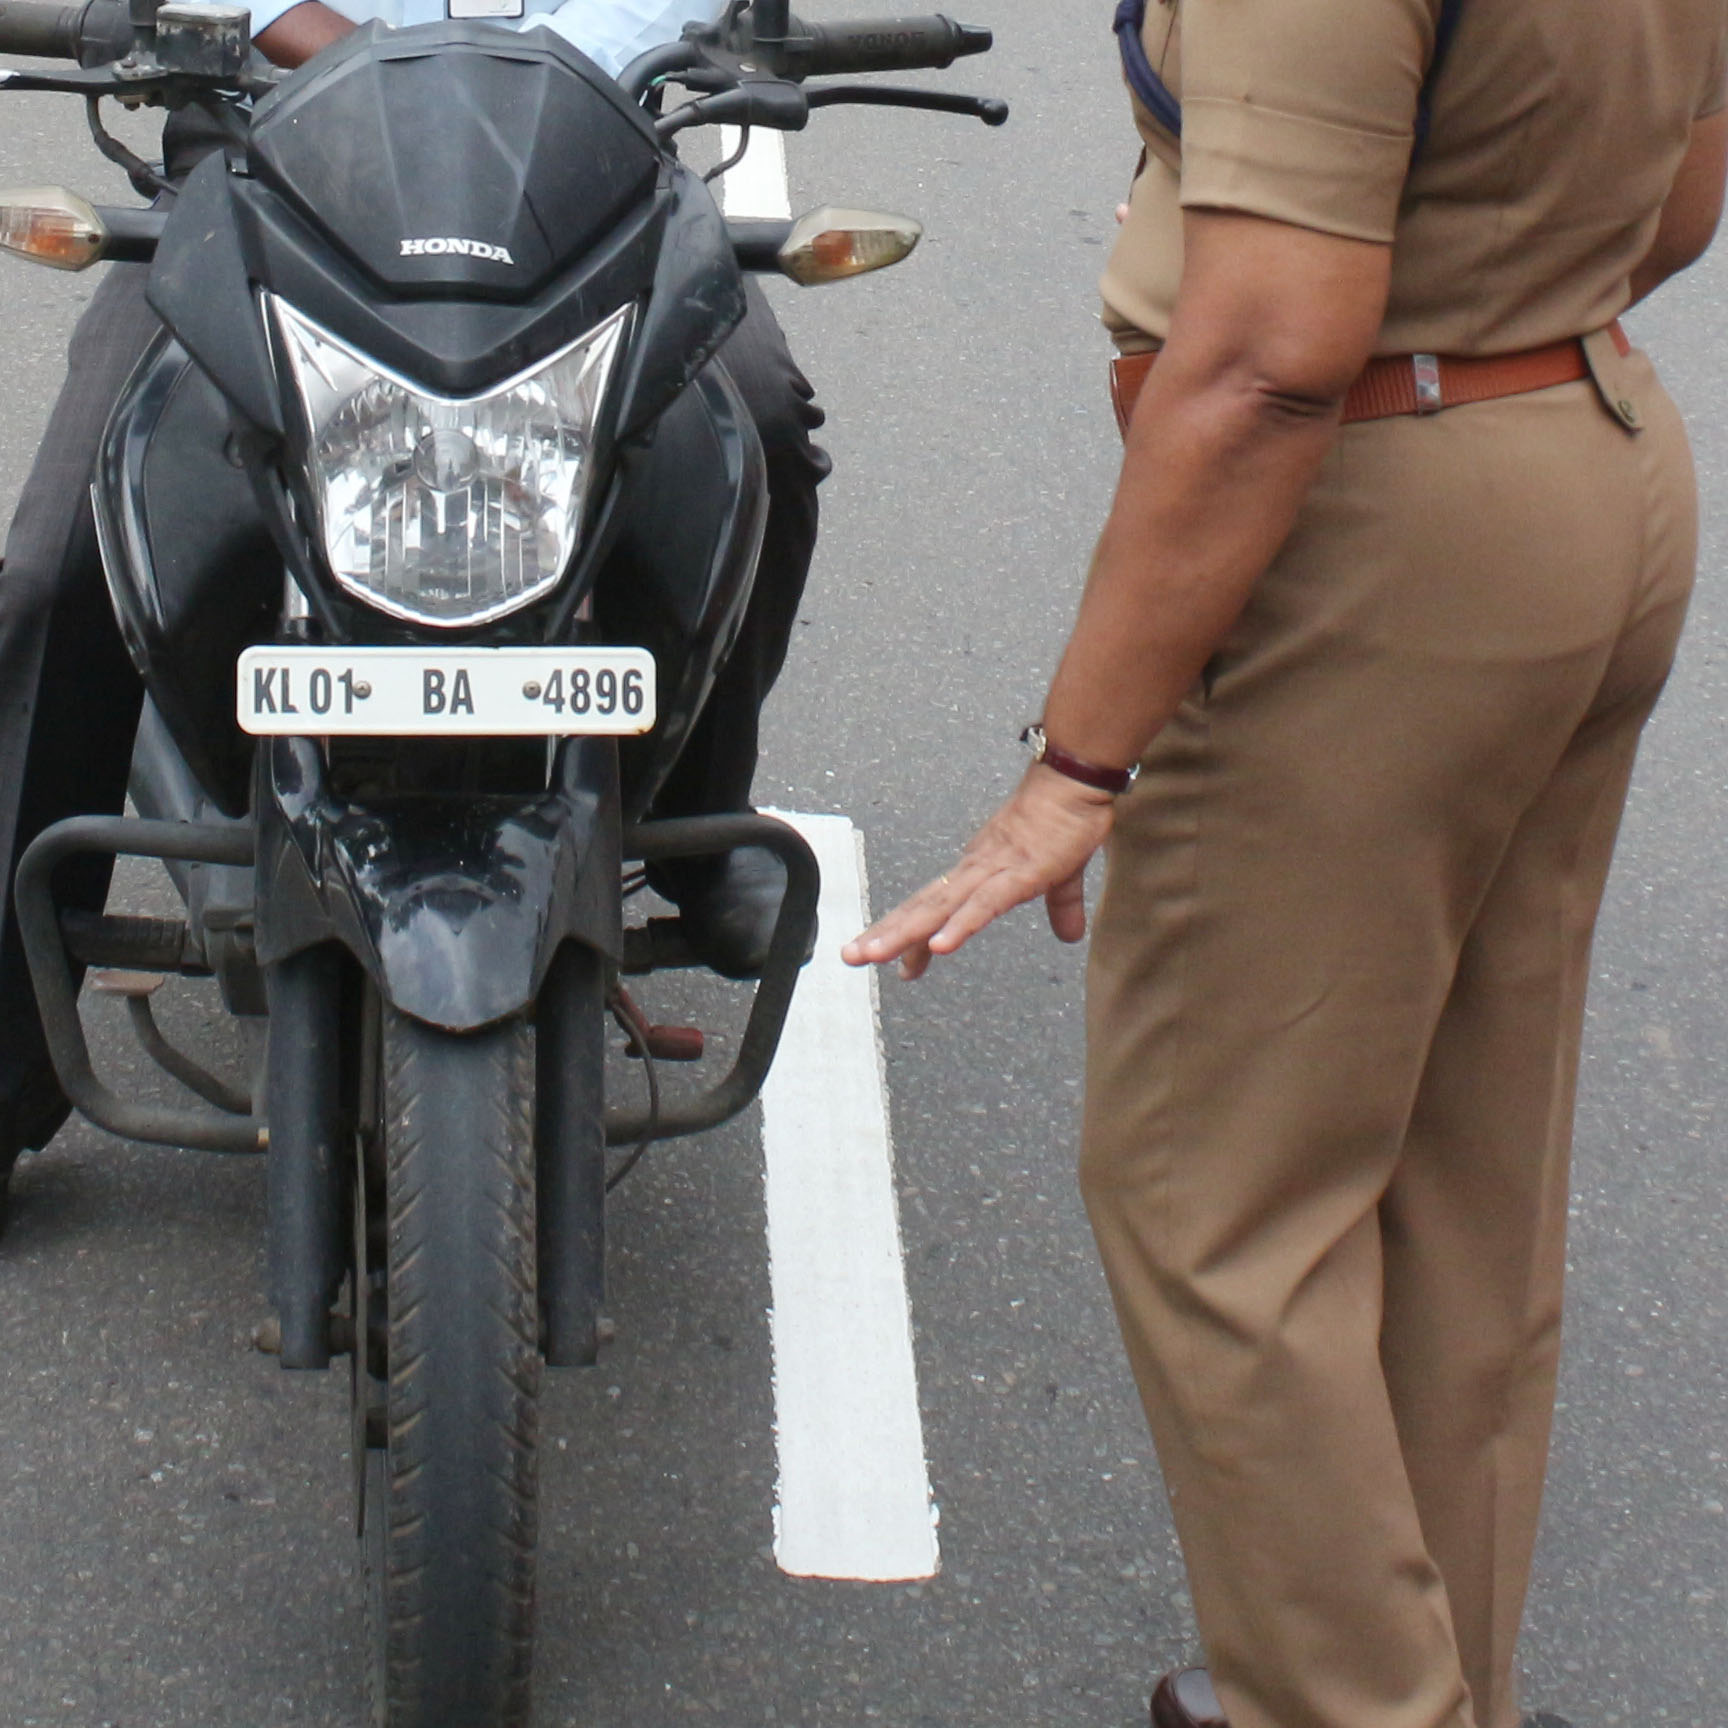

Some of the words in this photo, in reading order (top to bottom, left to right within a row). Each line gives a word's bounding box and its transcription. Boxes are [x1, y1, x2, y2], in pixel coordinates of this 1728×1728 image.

[399, 238, 514, 265] HONDA
[423, 669, 474, 715] BA
[542, 669, 644, 715] 4896
